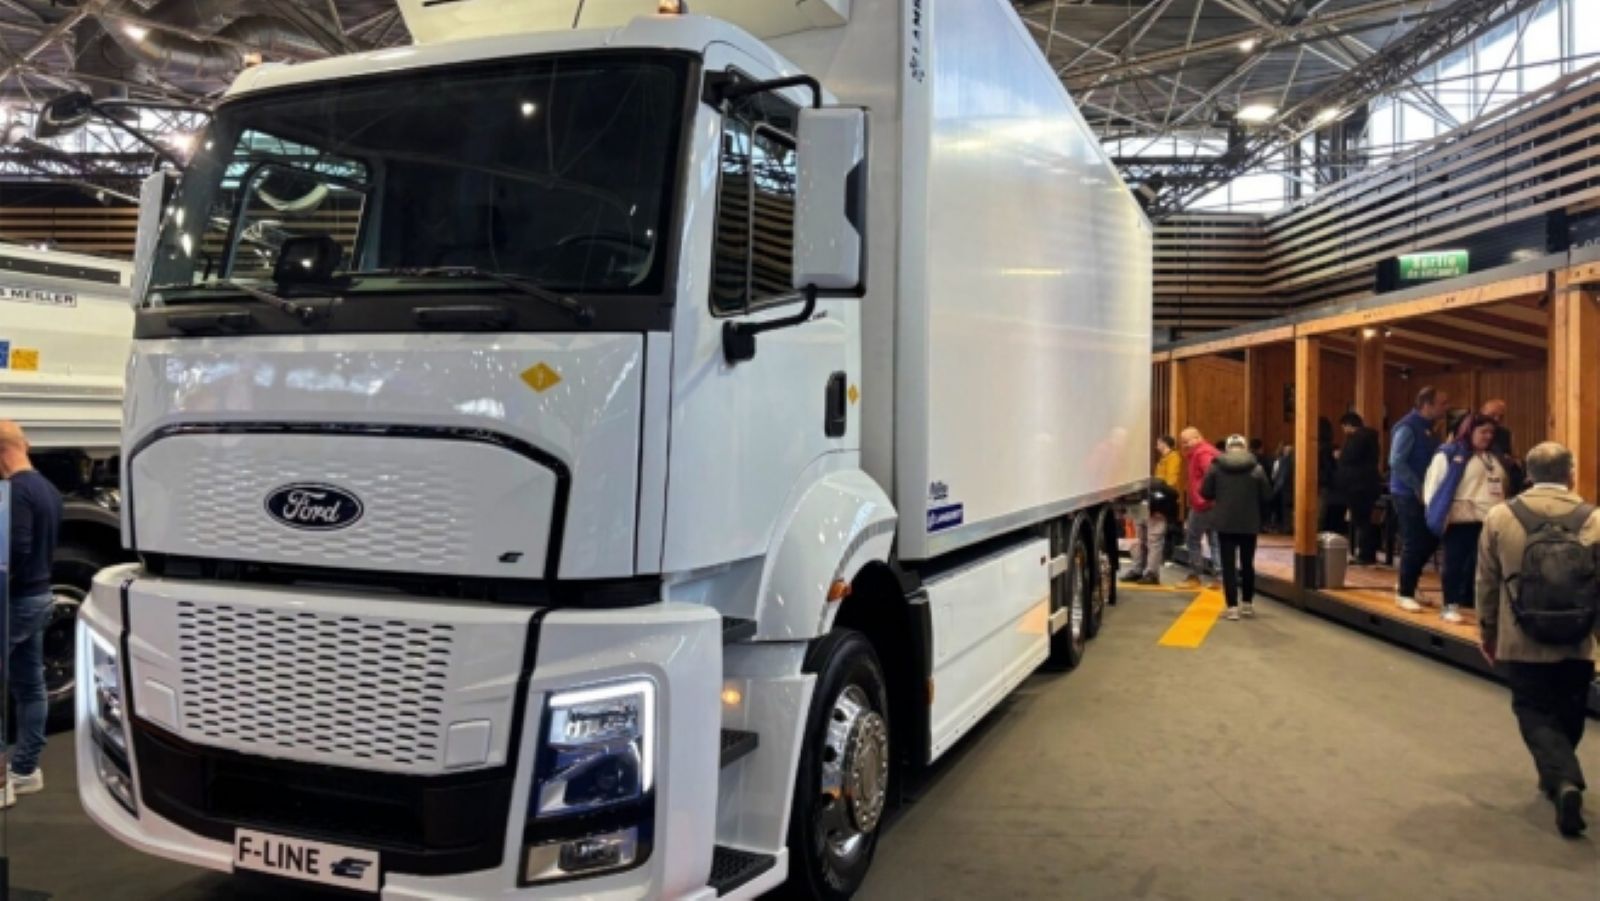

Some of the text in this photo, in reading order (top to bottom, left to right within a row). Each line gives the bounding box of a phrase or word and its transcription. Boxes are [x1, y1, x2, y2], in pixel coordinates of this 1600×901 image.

[11, 289, 73, 304] MEILLER
[283, 492, 341, 522] Ford
[239, 836, 321, 876] F-LINE
